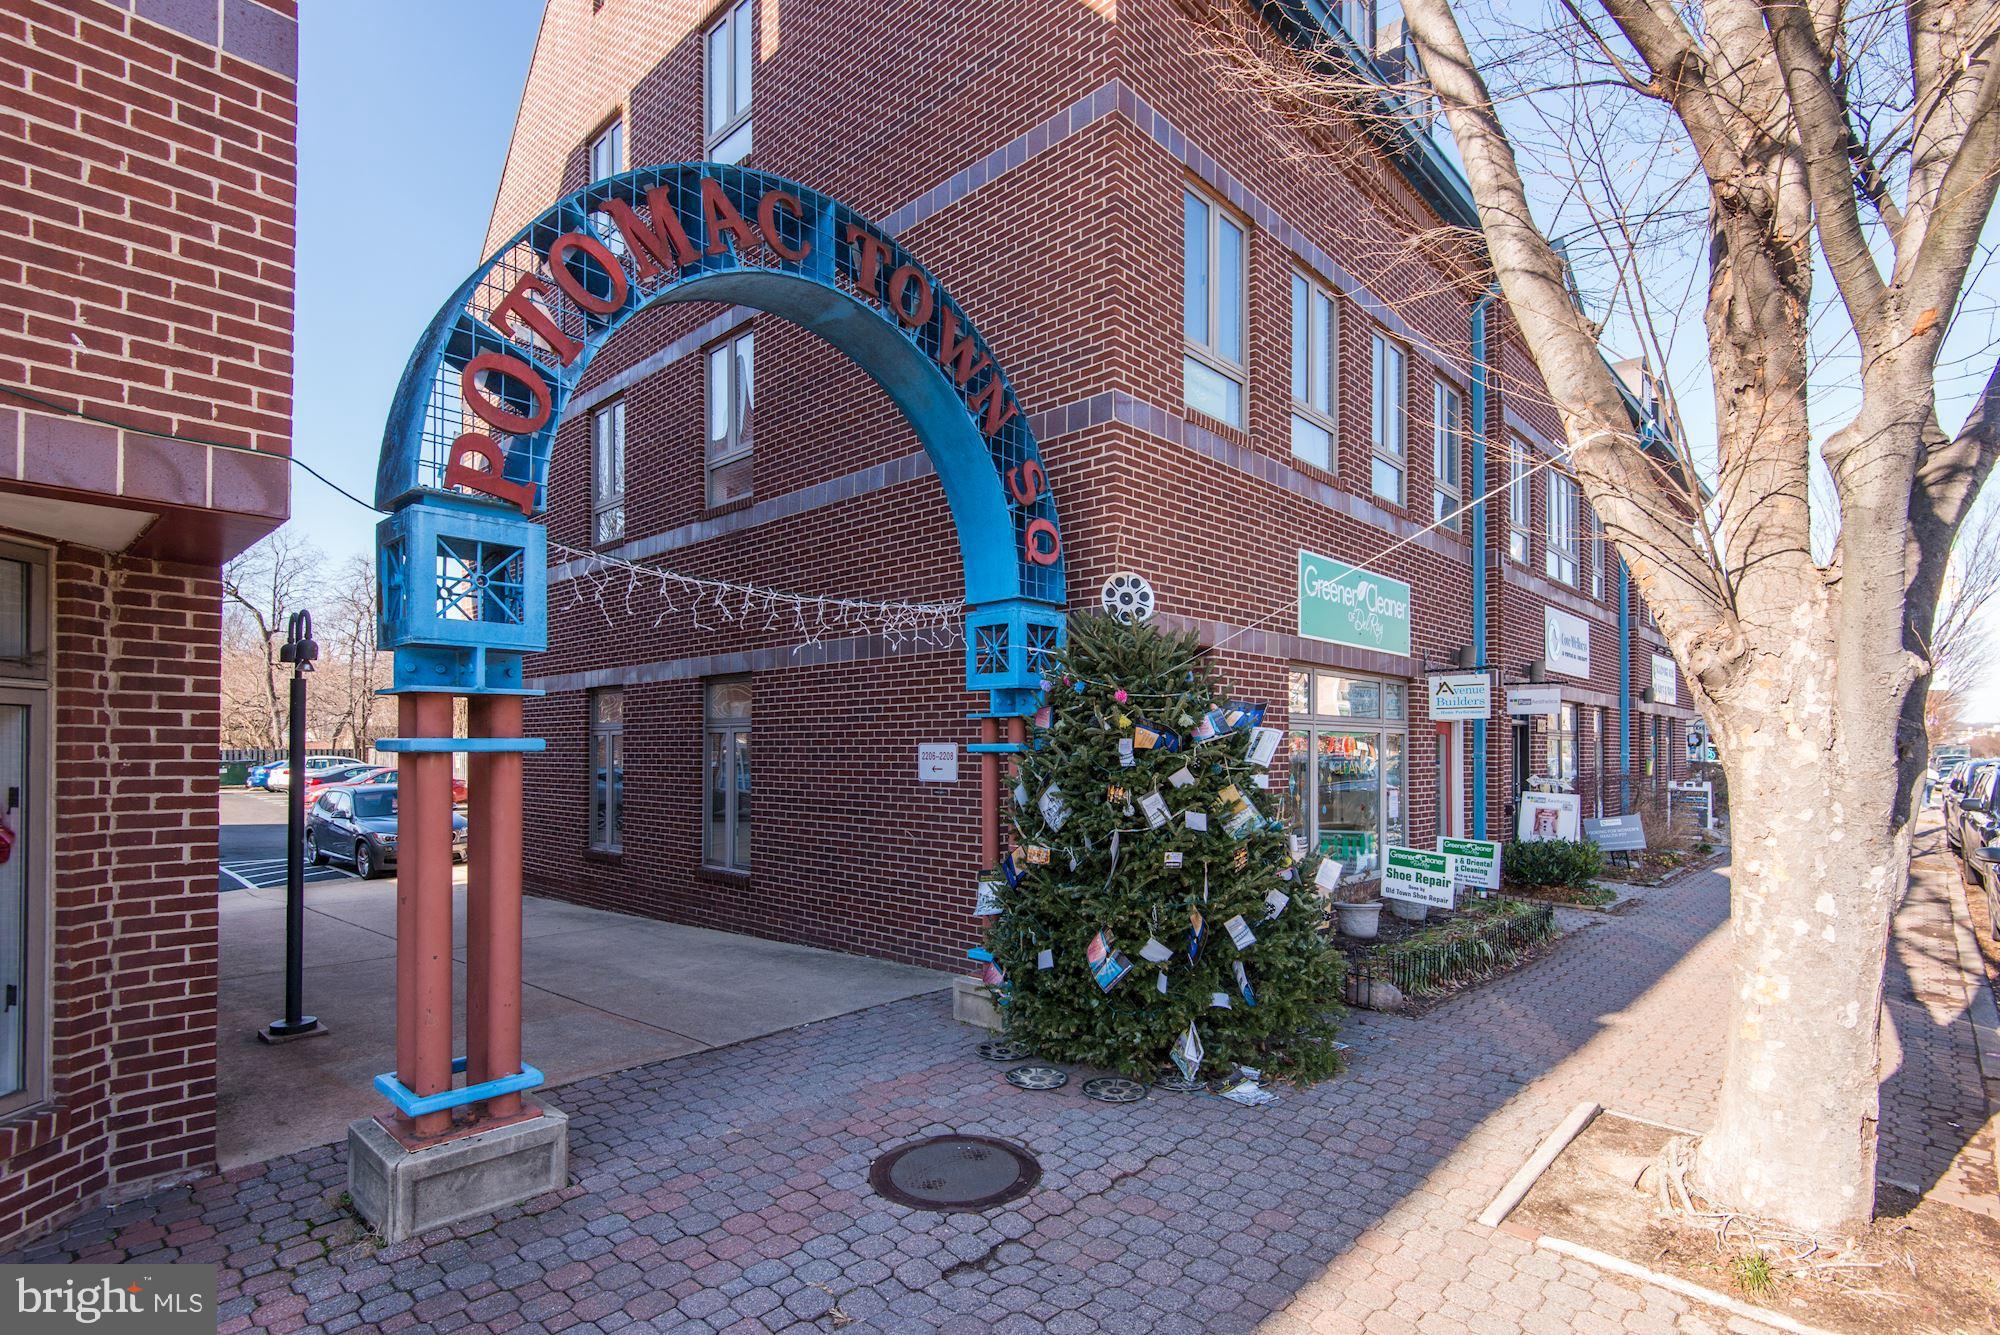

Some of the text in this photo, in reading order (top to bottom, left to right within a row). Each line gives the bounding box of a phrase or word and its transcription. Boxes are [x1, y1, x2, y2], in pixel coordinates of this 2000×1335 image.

[444, 176, 812, 516] POTOMAC
[846, 223, 1019, 438] TOWN
[1304, 564, 1407, 620] Greener Cleaner
[1436, 681, 1485, 695] Avenue
[1436, 696, 1486, 706] Builders
[1460, 865, 1488, 876] Cleaning
[1466, 858, 1493, 868] Oriental
[1386, 867, 1452, 888] Shoe Repair
[1385, 886, 1449, 904] Old Town Shoe Repair
